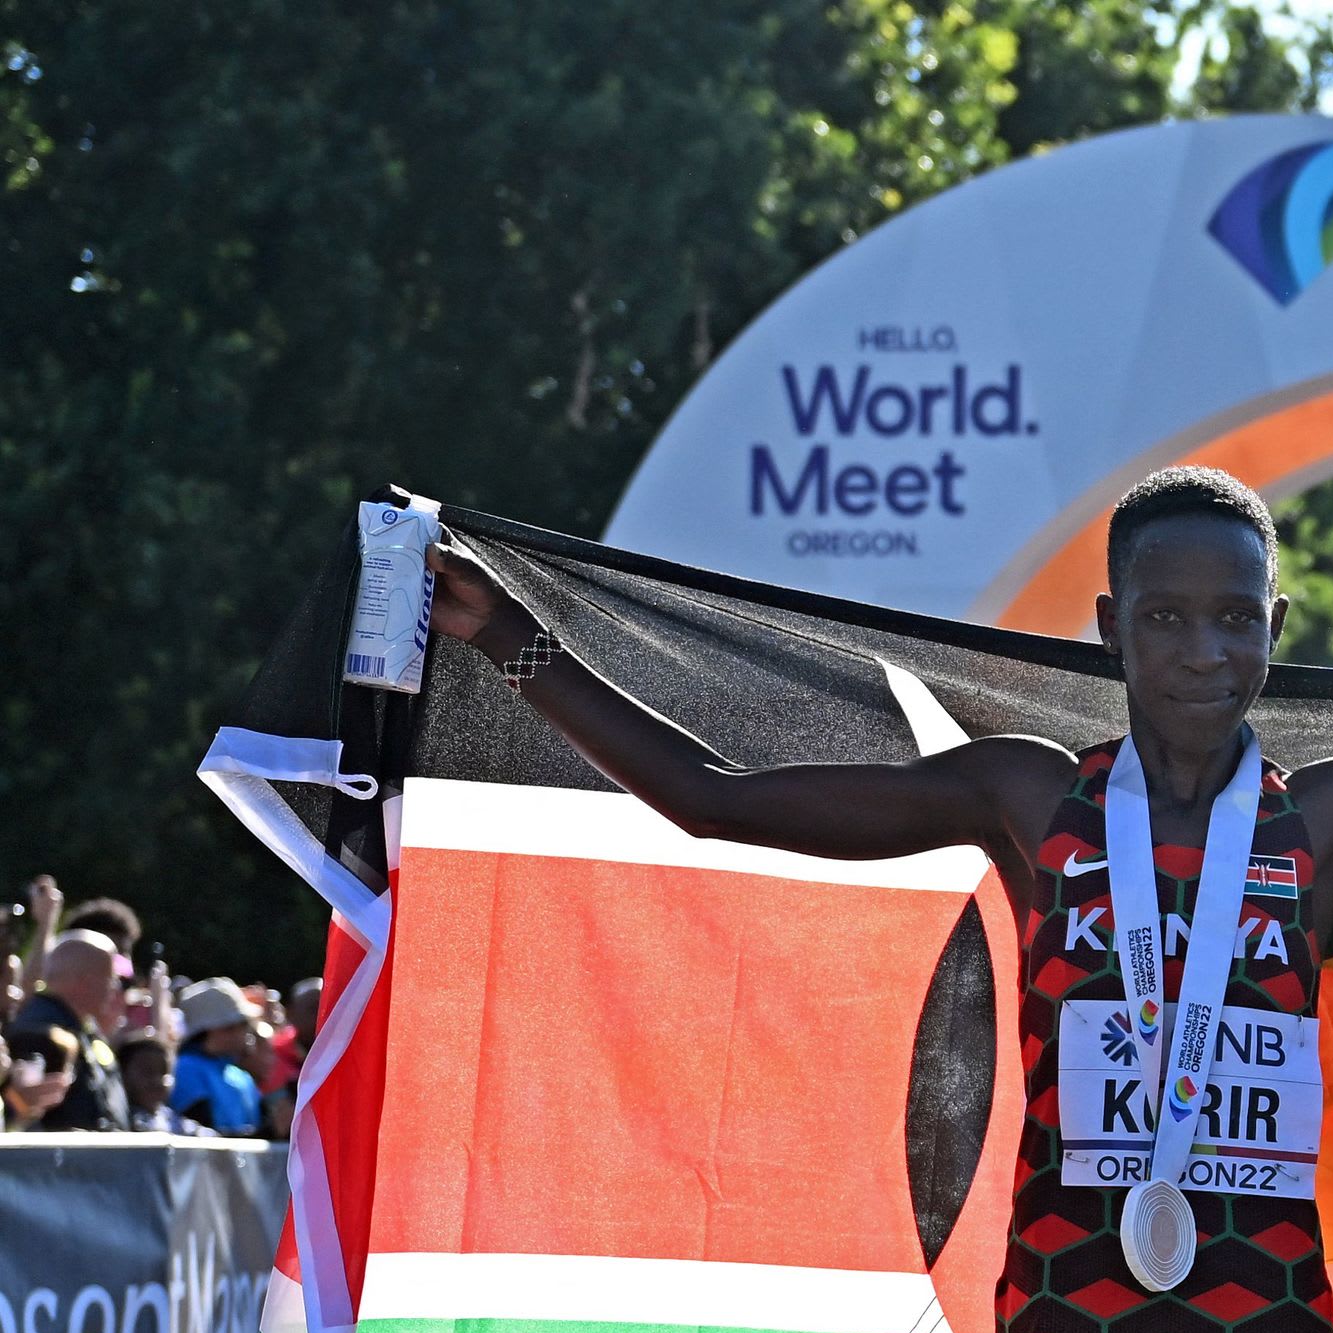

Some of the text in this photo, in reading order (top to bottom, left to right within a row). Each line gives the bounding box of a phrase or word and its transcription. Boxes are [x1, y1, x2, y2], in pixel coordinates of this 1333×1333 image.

[782, 364, 1039, 437] World.
[751, 444, 966, 517] Meet
[1135, 928, 1149, 995] CHAMPIONSHIPS
[1183, 1004, 1202, 1071] CHAMPIONSHIPS
